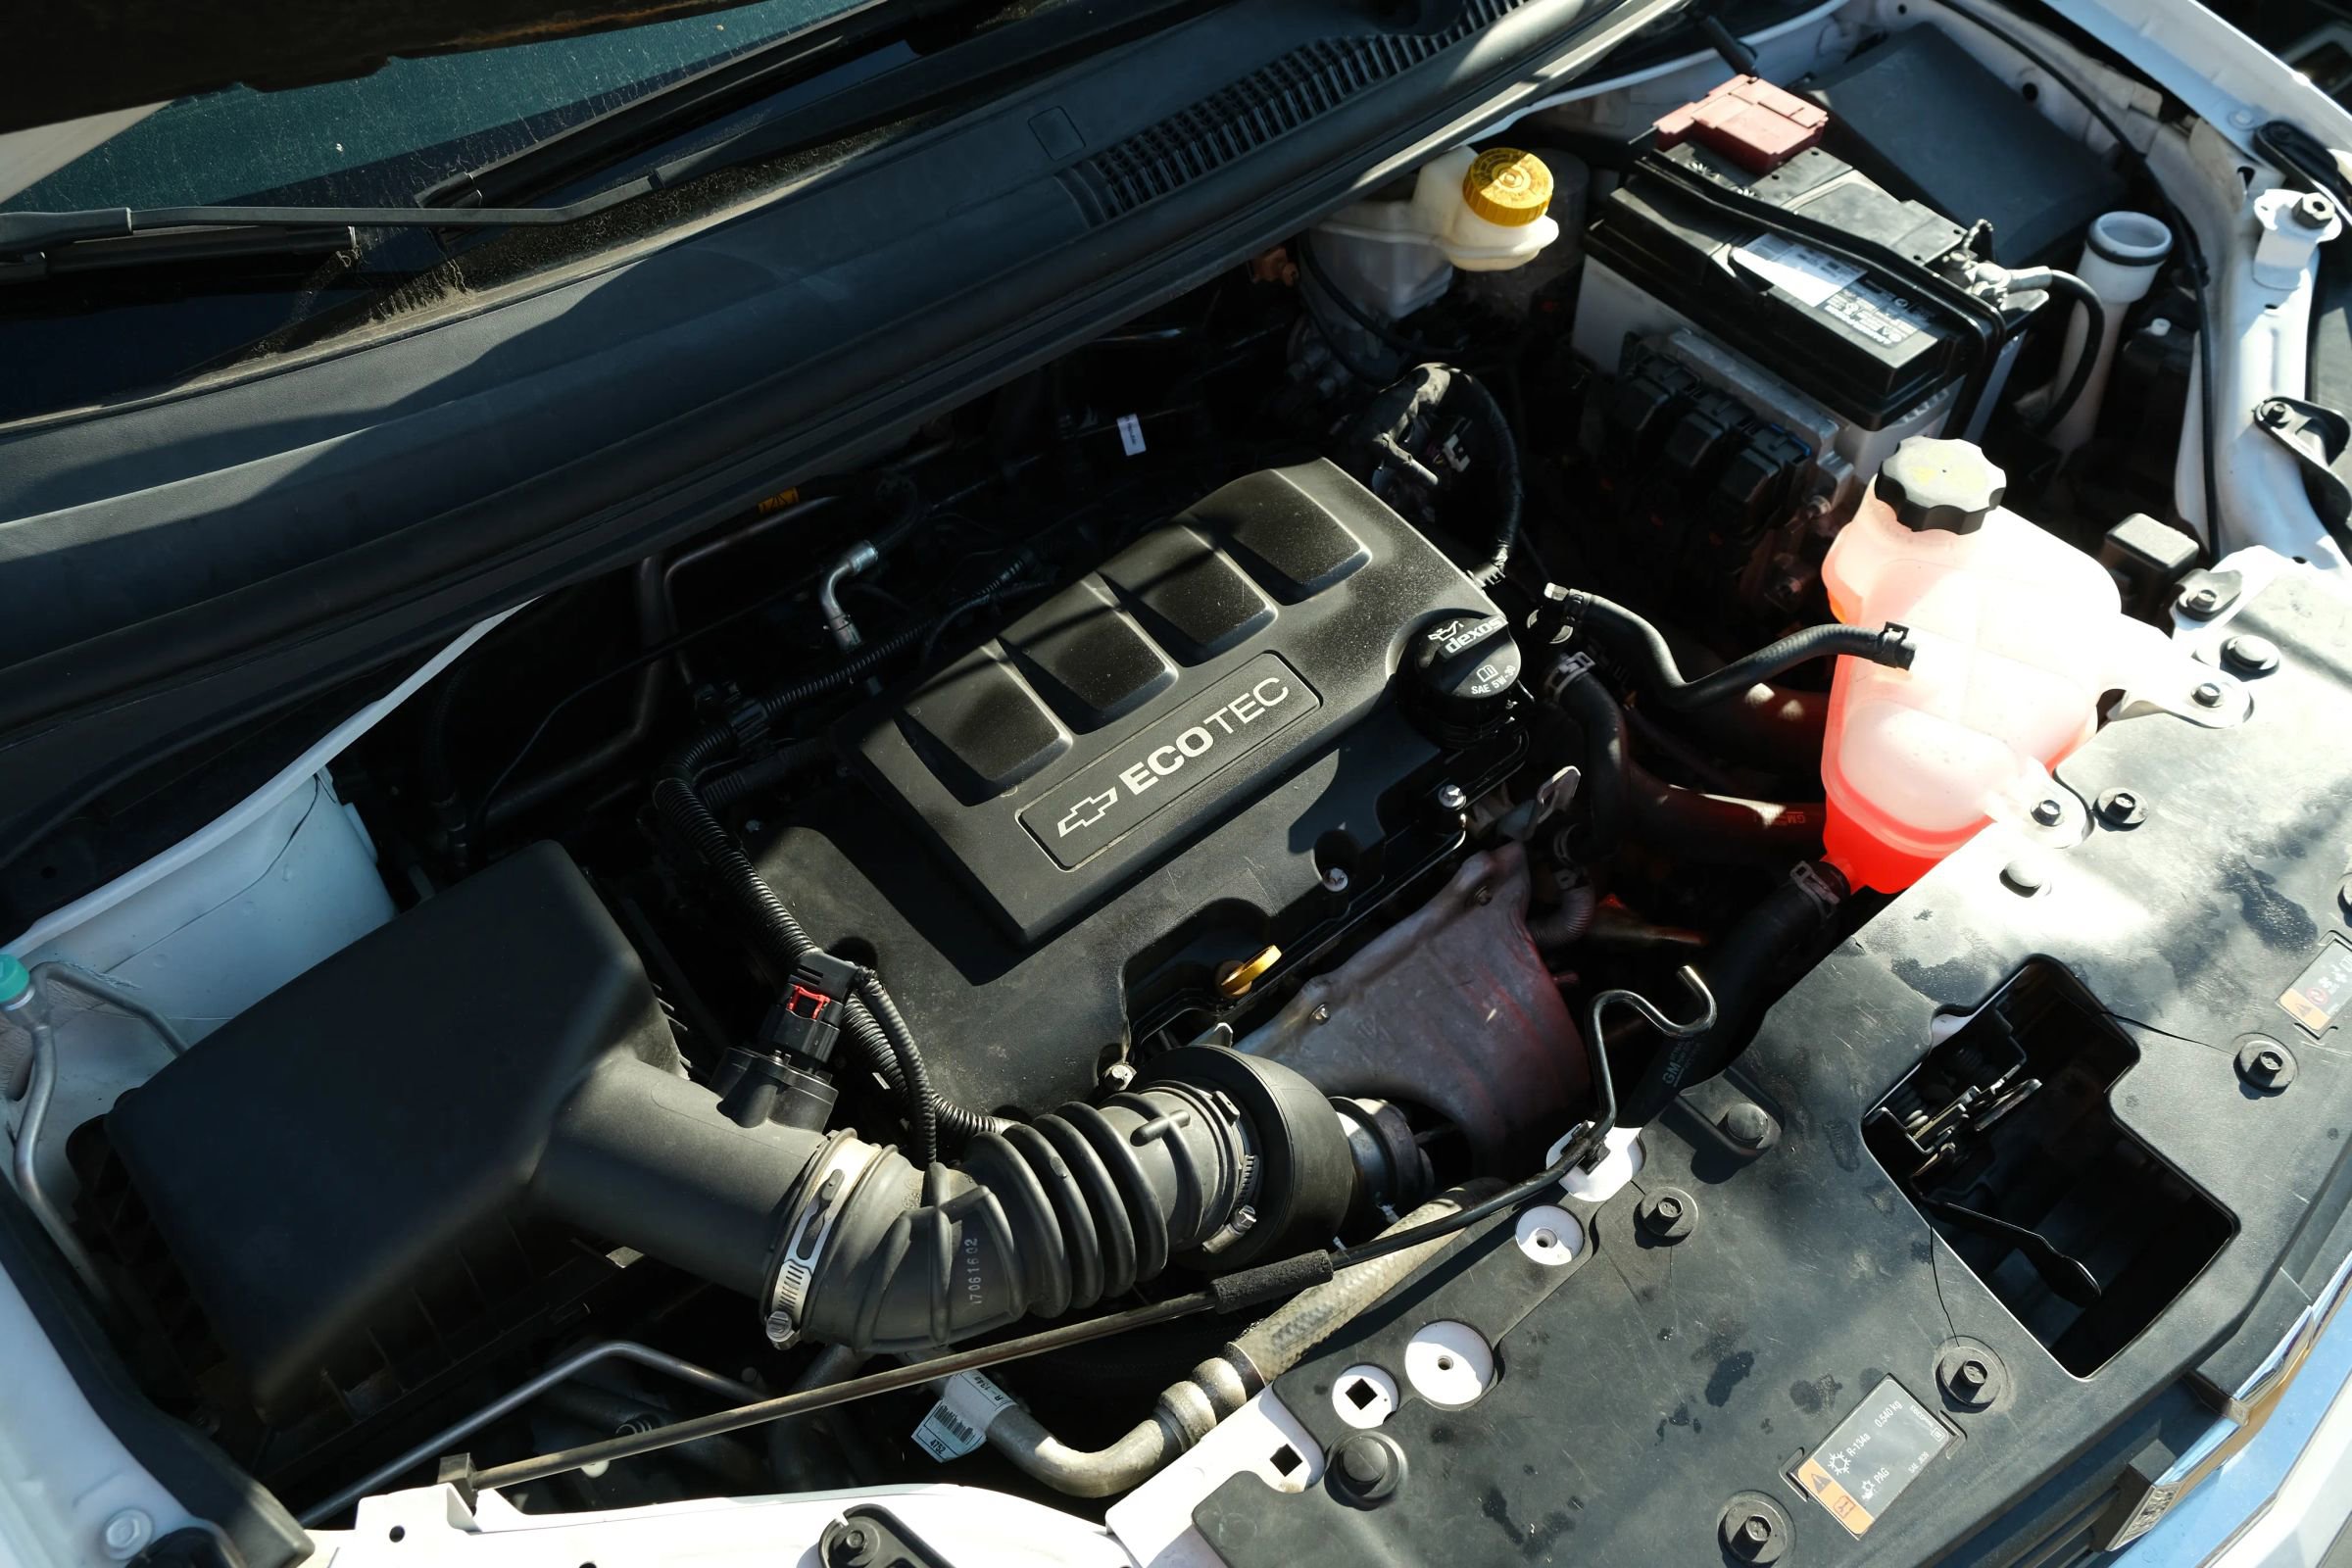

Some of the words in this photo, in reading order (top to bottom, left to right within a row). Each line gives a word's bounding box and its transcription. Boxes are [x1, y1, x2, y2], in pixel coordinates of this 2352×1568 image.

[1445, 616, 1503, 654] dexos
[1471, 683, 1491, 695] SAE
[1491, 664, 1516, 689] 5W-30
[1118, 677, 1289, 796] ECOTEC
[1662, 1061, 1682, 1085] GM
[1845, 1432, 1872, 1457] R-134a
[1874, 1407, 1894, 1428] 0.540
[1888, 1399, 1903, 1411] kg
[929, 1438, 947, 1455] 4752
[1873, 1467, 1890, 1484] PAG
